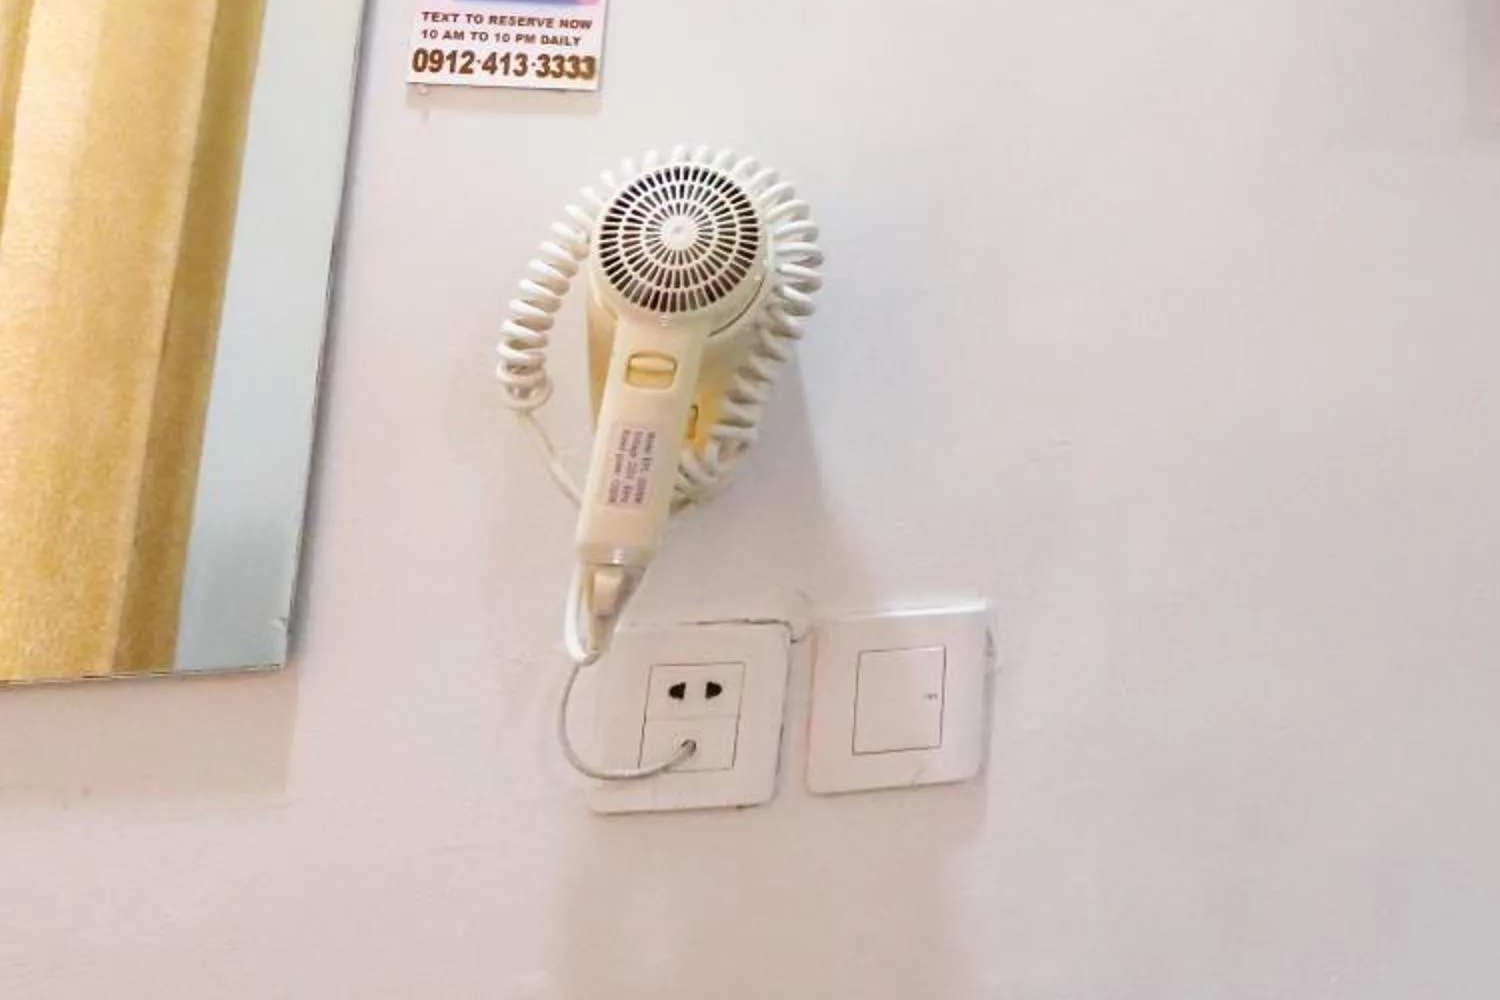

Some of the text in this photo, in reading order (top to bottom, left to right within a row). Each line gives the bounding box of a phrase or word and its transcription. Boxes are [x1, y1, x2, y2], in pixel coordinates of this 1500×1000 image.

[421, 11, 593, 30] TEXT TO RESERVE NOW
[421, 29, 582, 47] 10 AM TO 10 PM DAILY
